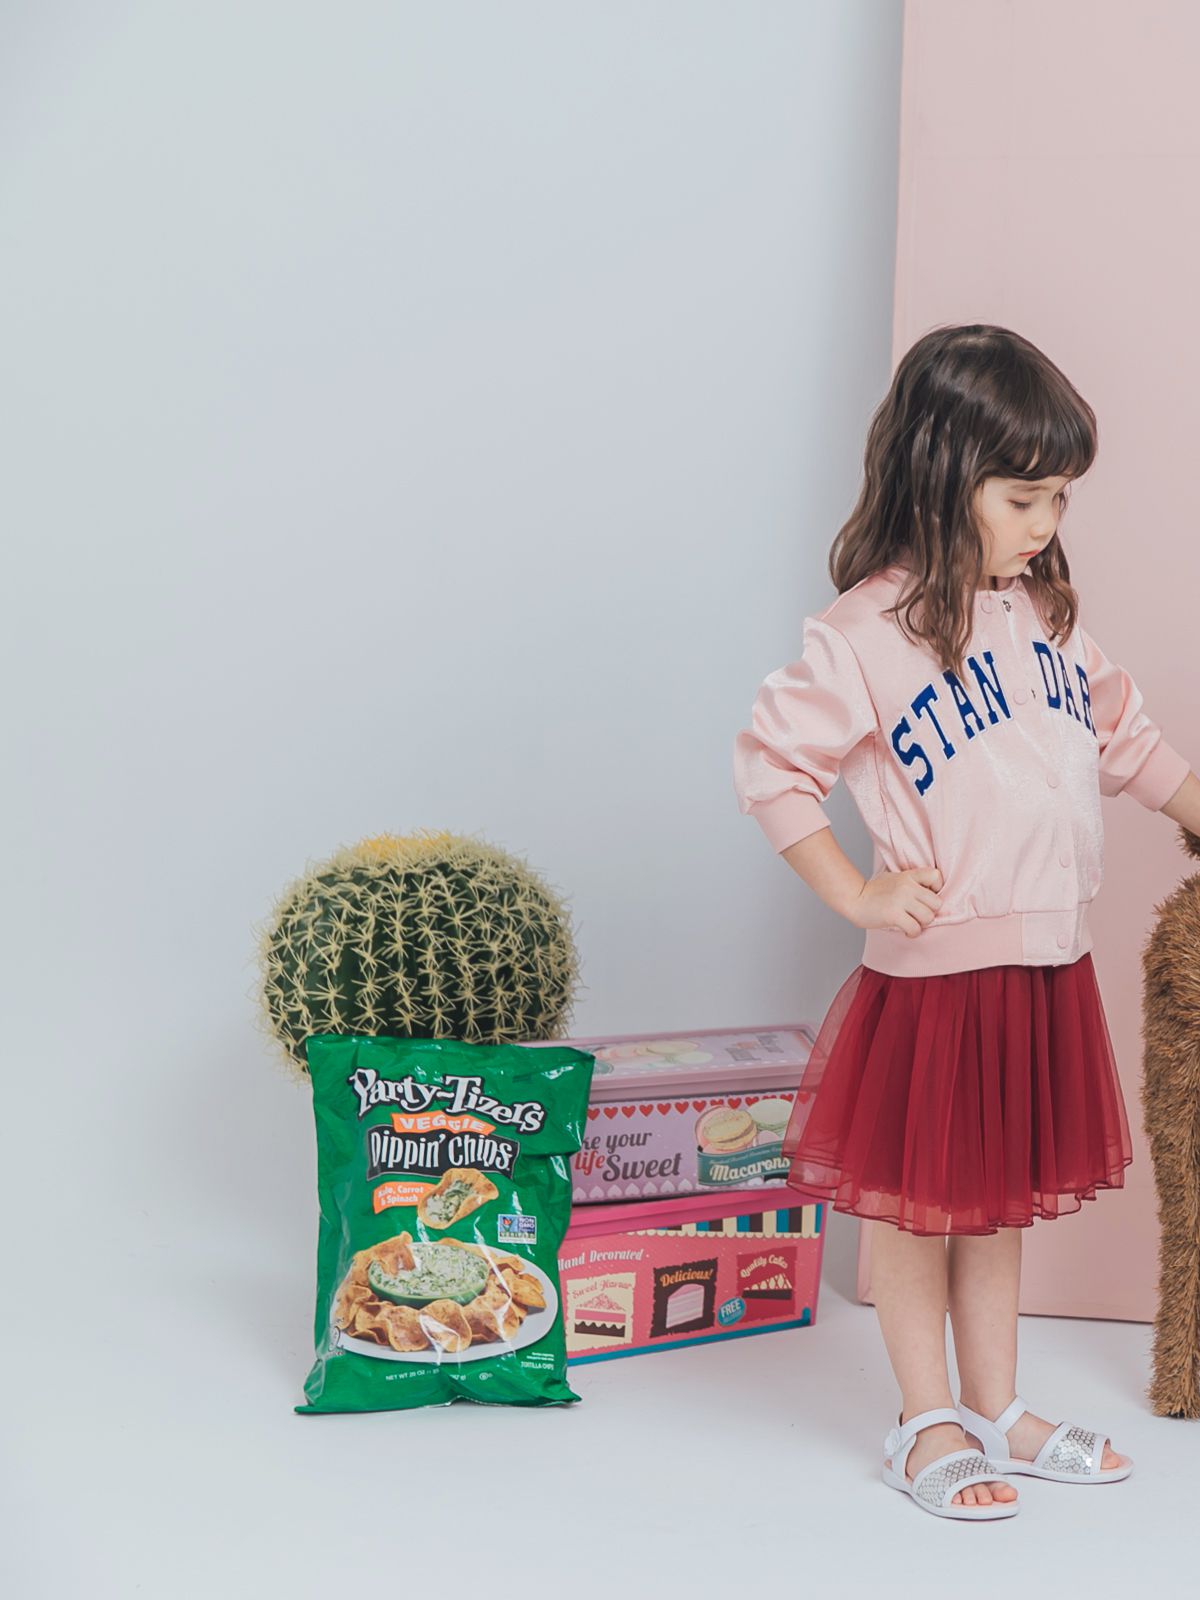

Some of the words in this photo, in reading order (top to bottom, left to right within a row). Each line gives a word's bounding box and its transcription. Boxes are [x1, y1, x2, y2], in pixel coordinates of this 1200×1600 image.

[348, 1067, 545, 1132] Party-Tizers
[399, 1115, 486, 1130] VEGGIE
[370, 1130, 446, 1169] Dippin'
[606, 1132, 652, 1154] your
[575, 1150, 605, 1176] life
[602, 1153, 682, 1182] Sweet
[709, 1157, 791, 1181] Macarons
[589, 1248, 645, 1263] Decorated
[740, 1256, 767, 1278] Quality
[768, 1254, 788, 1270] Cakes
[660, 1268, 714, 1287] Delicious!
[720, 1298, 741, 1318] FREE
